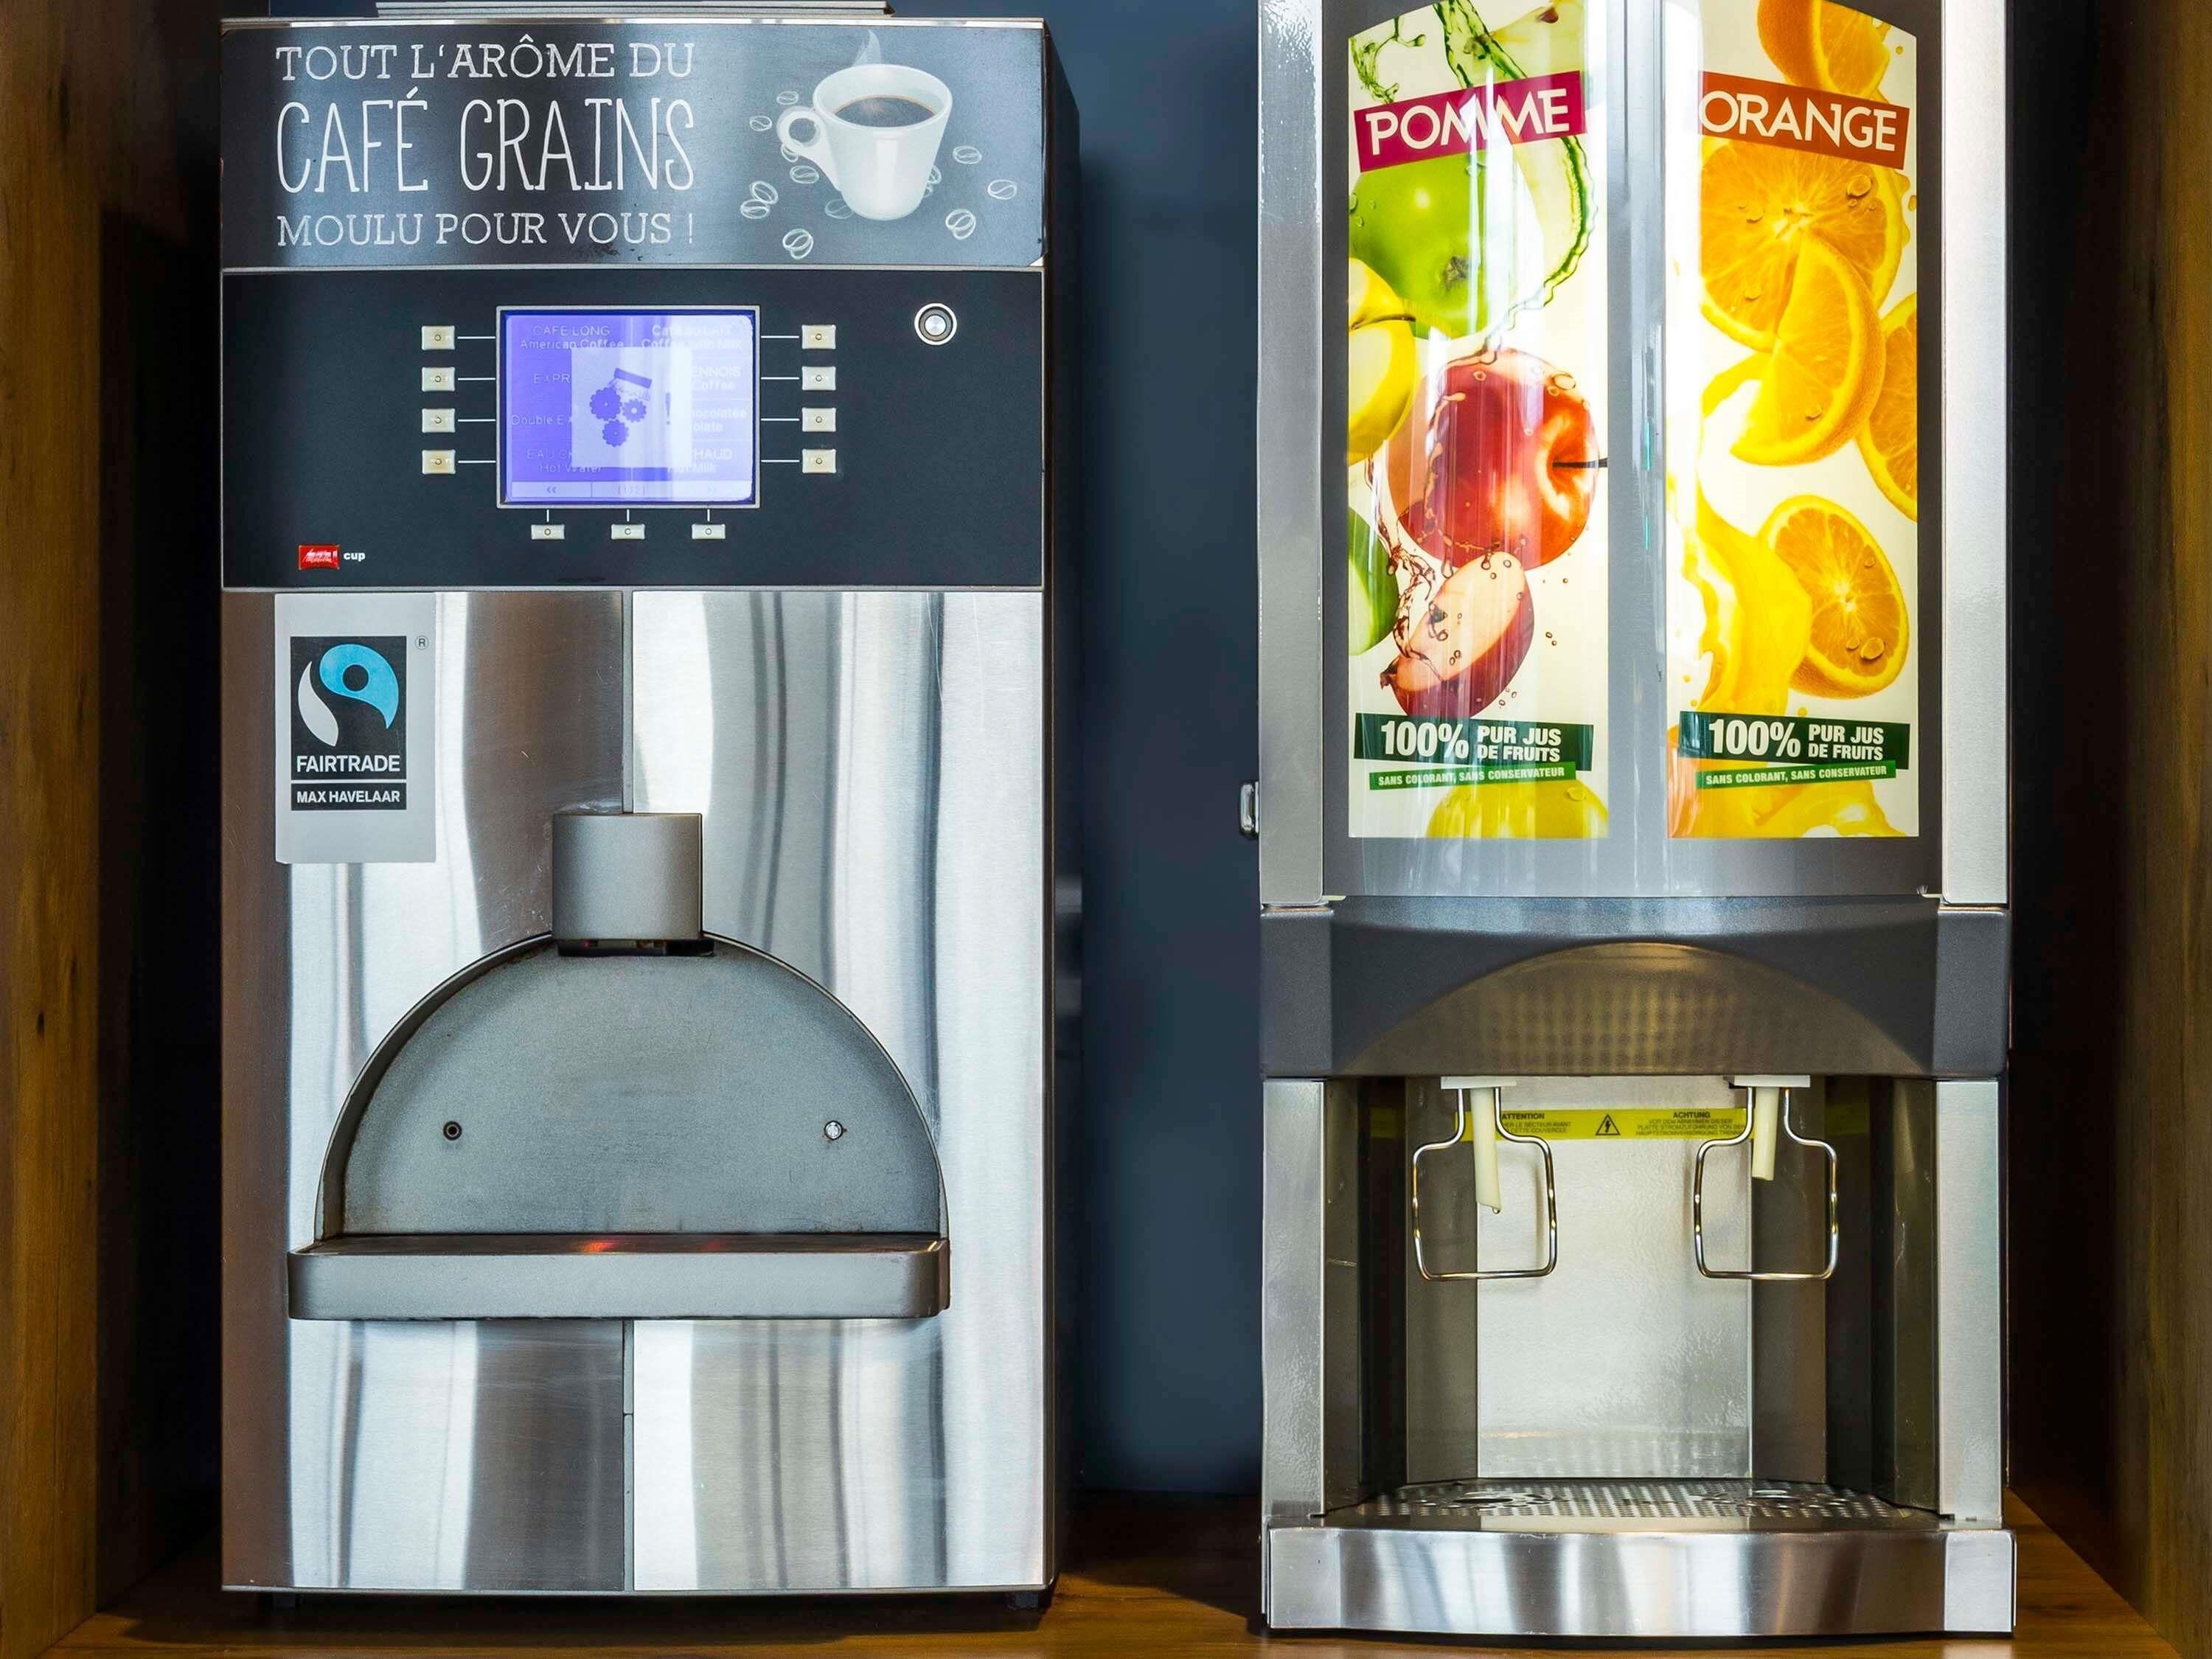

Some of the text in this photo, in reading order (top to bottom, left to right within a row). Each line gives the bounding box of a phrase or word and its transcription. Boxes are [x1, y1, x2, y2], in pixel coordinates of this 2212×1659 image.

[276, 45, 397, 81] TOUT
[628, 42, 694, 78] DU
[1365, 87, 1570, 156] POMME
[1699, 88, 1898, 153] ORANGE
[276, 86, 694, 193] CAFÉ GRAINS
[277, 212, 423, 247] MOULU
[435, 212, 547, 245] POUR
[558, 212, 671, 246] VOUS
[572, 325, 611, 337] LONG
[533, 373, 571, 384] EXPR
[511, 414, 553, 425] Double
[343, 552, 366, 563] cup
[1381, 720, 1562, 759] 100% PUR JUS
[1709, 718, 1884, 757] 100% PUR JUS
[1477, 744, 1560, 762] DE FRUITS
[1808, 743, 1883, 761] DE FRUITS
[296, 755, 400, 773] FAIRTRADE
[1378, 767, 1565, 787] SANS COLORANT, SANS CONSERVATEUR
[1705, 765, 1887, 786] SANS COLORANT, SANS CONSERVATEUR
[296, 790, 400, 804] MAX HAVELAAR
